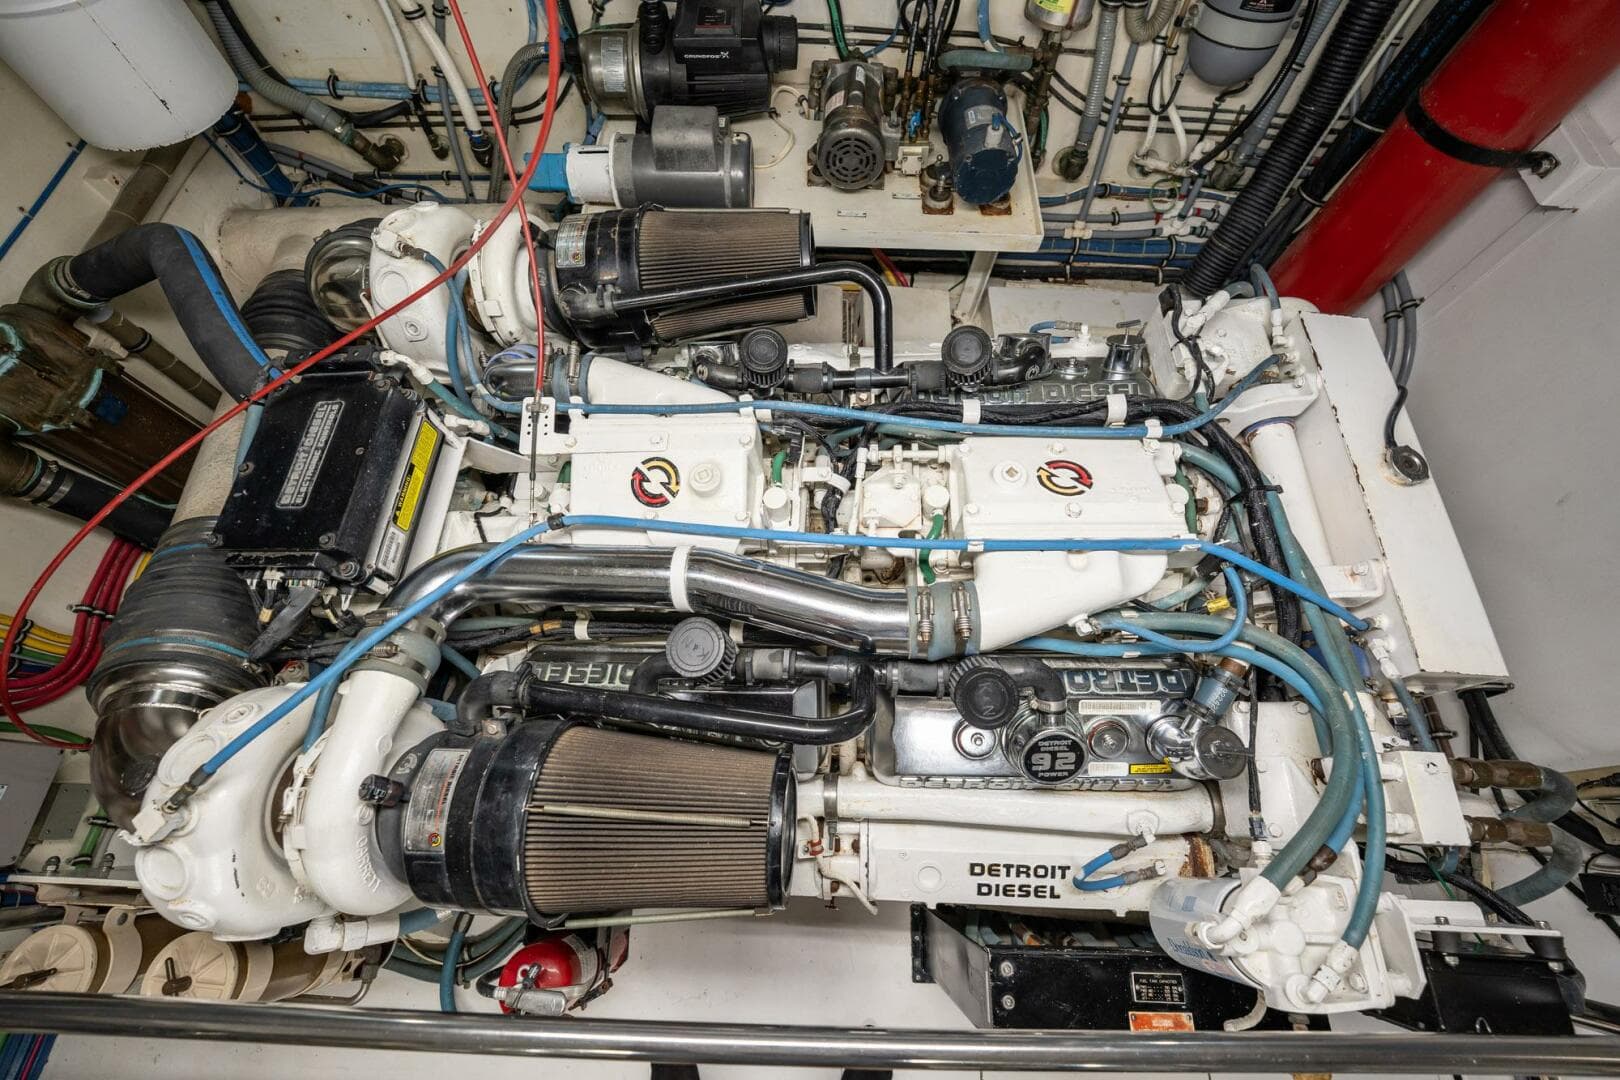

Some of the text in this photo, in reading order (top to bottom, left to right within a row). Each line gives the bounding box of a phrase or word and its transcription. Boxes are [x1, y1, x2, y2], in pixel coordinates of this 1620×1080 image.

[303, 403, 328, 448] DIESEL
[1031, 752, 1076, 771] 92
[969, 862, 1071, 880] DETROIT
[976, 882, 1061, 899] DIESEL
